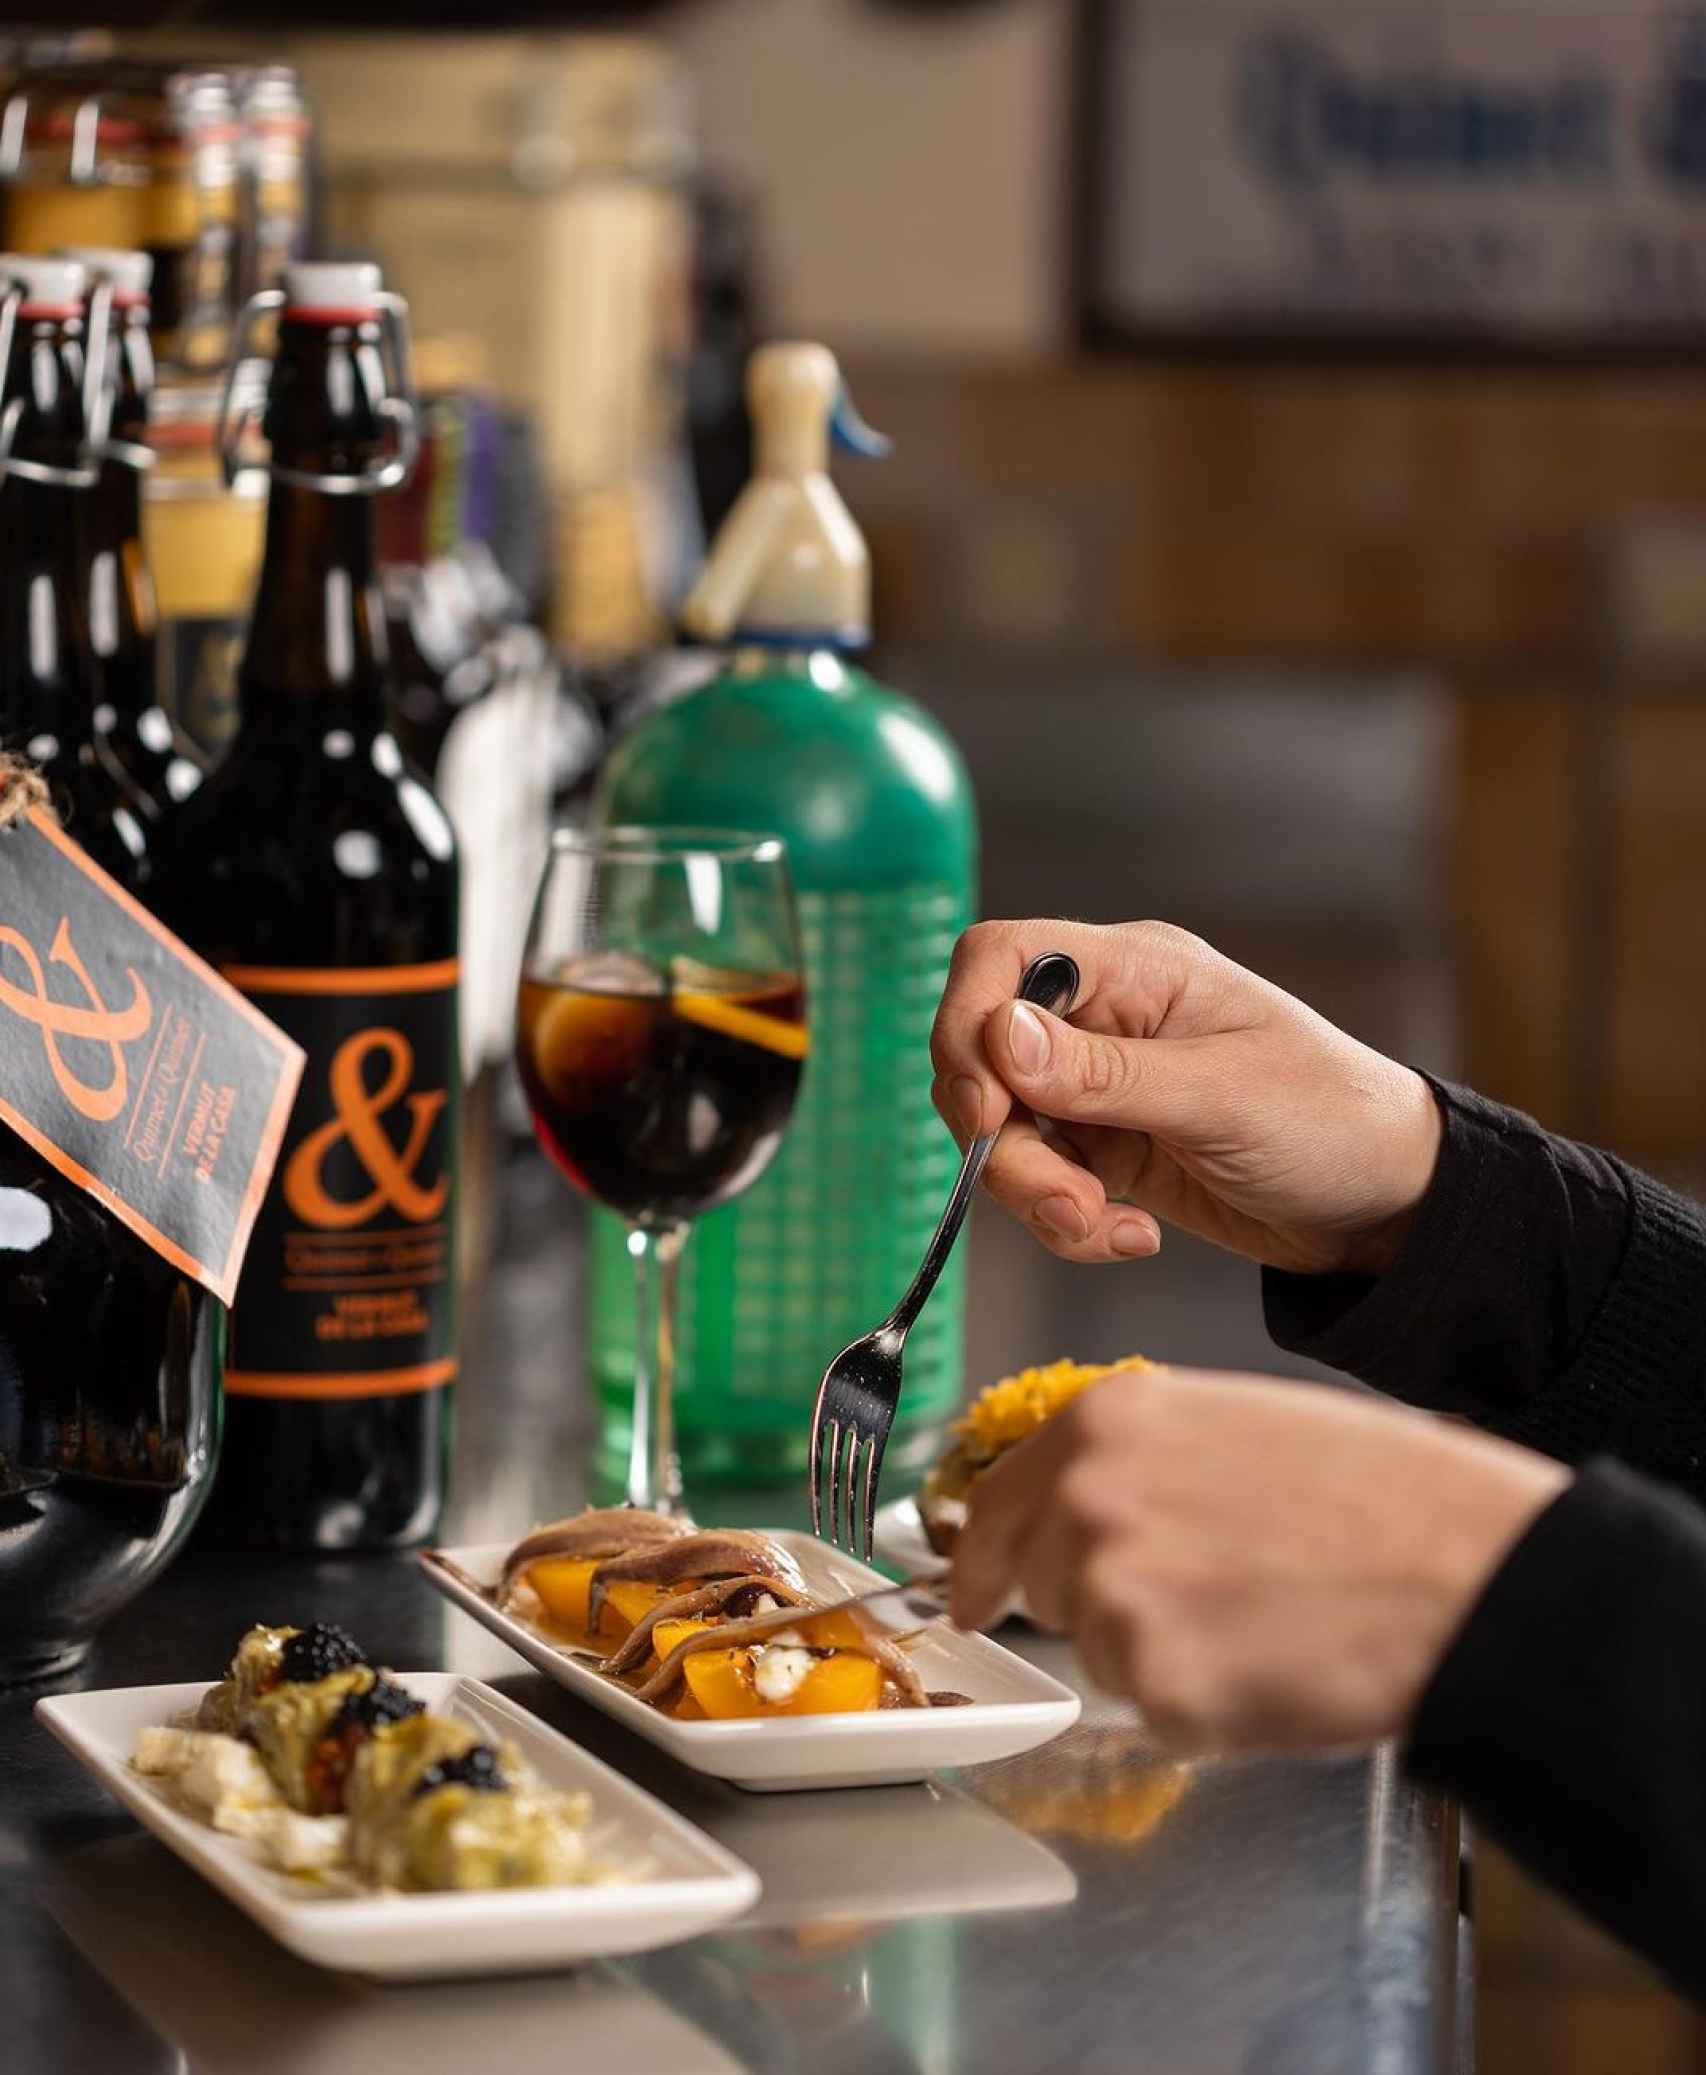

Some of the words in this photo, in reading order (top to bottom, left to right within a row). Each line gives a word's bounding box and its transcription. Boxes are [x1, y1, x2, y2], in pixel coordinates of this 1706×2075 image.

[0, 914, 152, 1122] &
[183, 1080, 216, 1157] VERMUT
[283, 1026, 450, 1229] &
